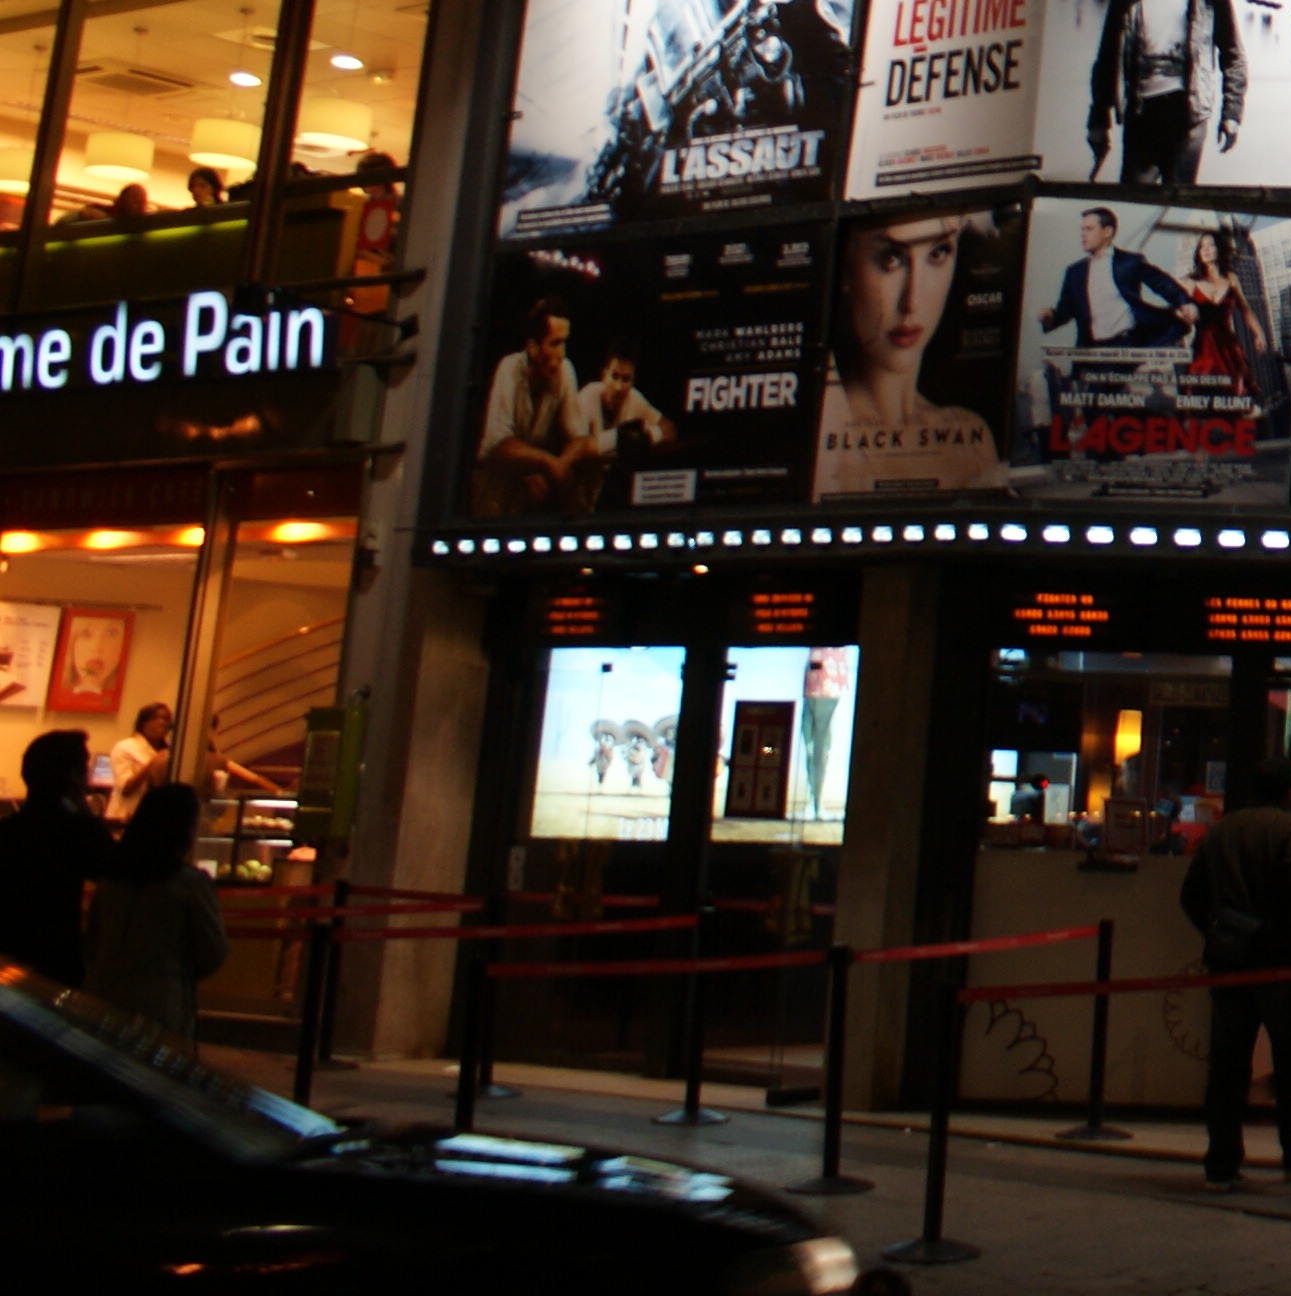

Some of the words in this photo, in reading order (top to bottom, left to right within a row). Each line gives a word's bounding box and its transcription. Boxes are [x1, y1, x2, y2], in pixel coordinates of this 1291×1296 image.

[885, 40, 1022, 107] DÉFENSE
[660, 129, 826, 184] L'ASSAUT
[91, 301, 165, 383] de
[184, 291, 324, 376] Pain
[733, 321, 804, 337] WAHLBERG
[685, 372, 799, 413] FIGHTER
[1060, 392, 1095, 407] MATT
[1097, 393, 1147, 408] DAMON
[1176, 395, 1211, 409] EMILY
[1213, 396, 1252, 410] BLUNT
[827, 430, 902, 449] BLACK
[920, 427, 984, 447] SWAN
[1049, 413, 1257, 456] L'AGENCE
